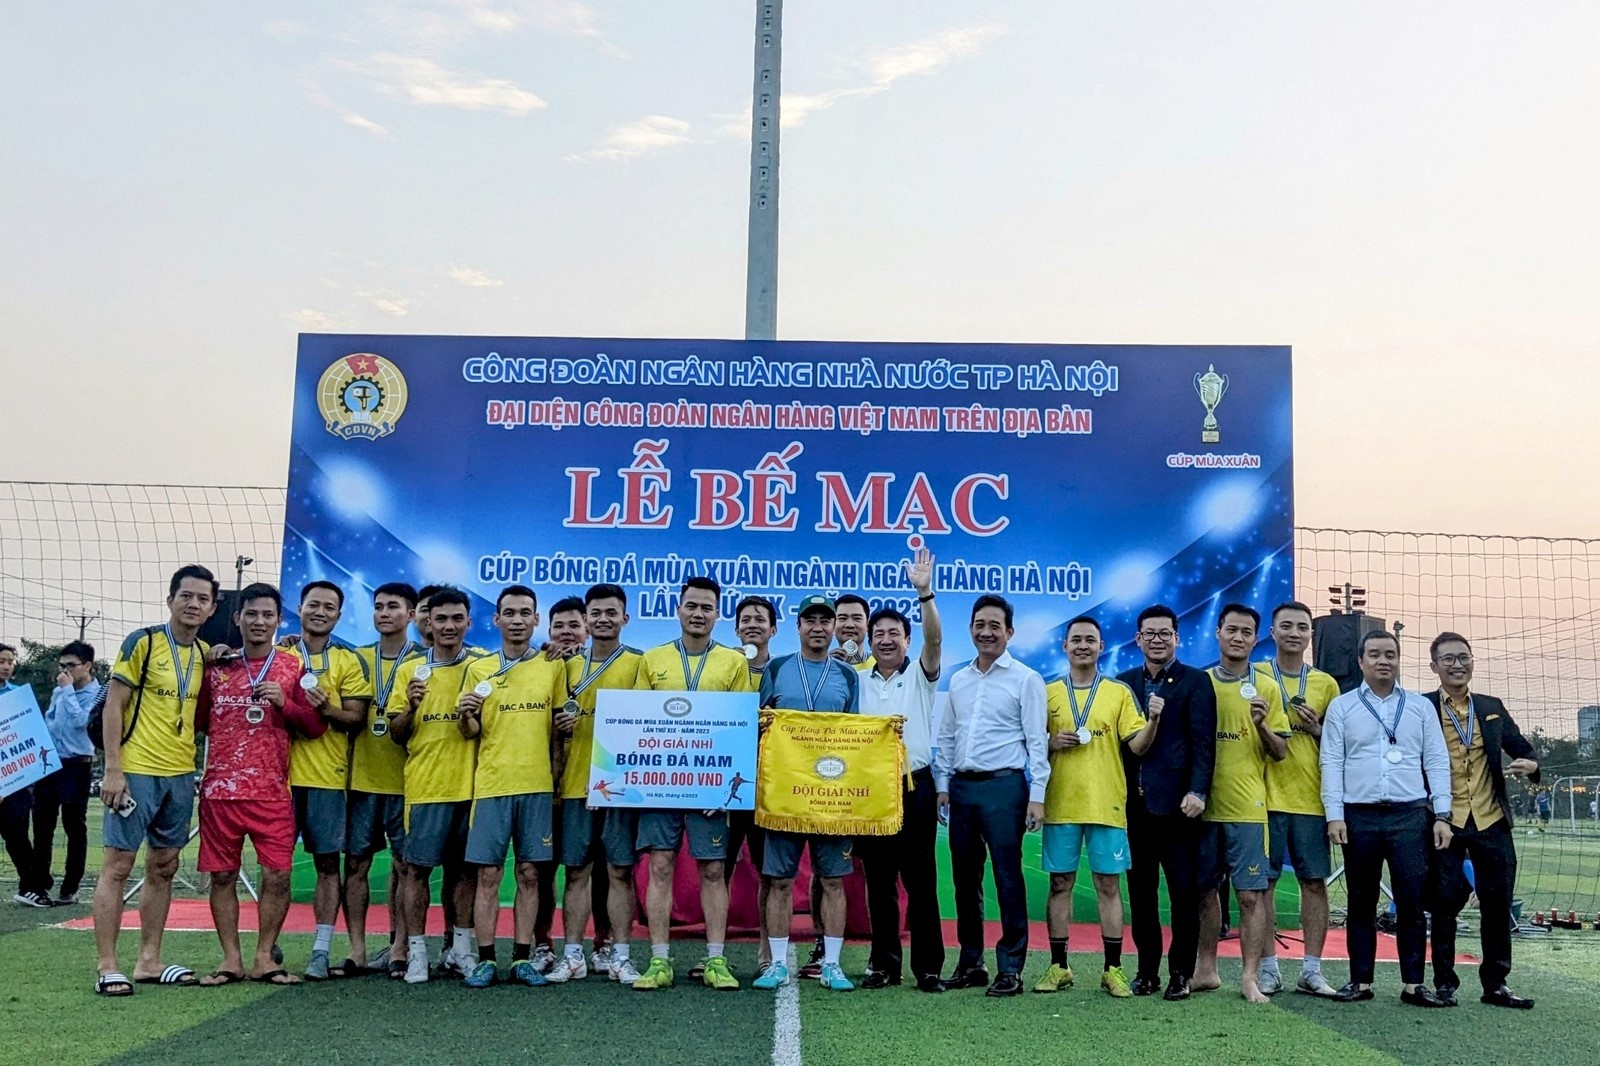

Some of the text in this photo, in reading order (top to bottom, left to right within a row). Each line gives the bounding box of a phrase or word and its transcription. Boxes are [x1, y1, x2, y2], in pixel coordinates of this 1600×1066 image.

[463, 352, 1118, 396] CÔNG ĐOÀN NGÂN HÀNG NHÀ NƯỚC TP HÀ NỘI
[487, 397, 1092, 438] ĐẠI DIỆN CÔNG ĐOÀN NGÂN HÀNG VIỆT NAM TRÊN ĐỊA BÀN
[1167, 453, 1260, 468] CÚP MÙA XUÂN
[563, 438, 1009, 550] LỄ BẾ MẠC
[479, 551, 1091, 600] CÚP BÓNG ĐÁ MÙA XUÂN NGÀNH NGÂ HÀNG HÀ NỘI
[157, 689, 176, 697] BAC
[246, 696, 271, 705] BNK
[423, 713, 441, 722] BAC
[638, 736, 660, 750] ĐỘI
[663, 737, 688, 749] GIẢI
[1217, 732, 1240, 740] BANK
[9, 737, 36, 756] NAM
[17, 752, 36, 768] VND
[616, 751, 732, 768] BÓNG ĐÁ NAM
[623, 771, 723, 786] 15.000.000 VND
[792, 784, 814, 797] ĐỘI
[818, 785, 843, 797] GIẢI
